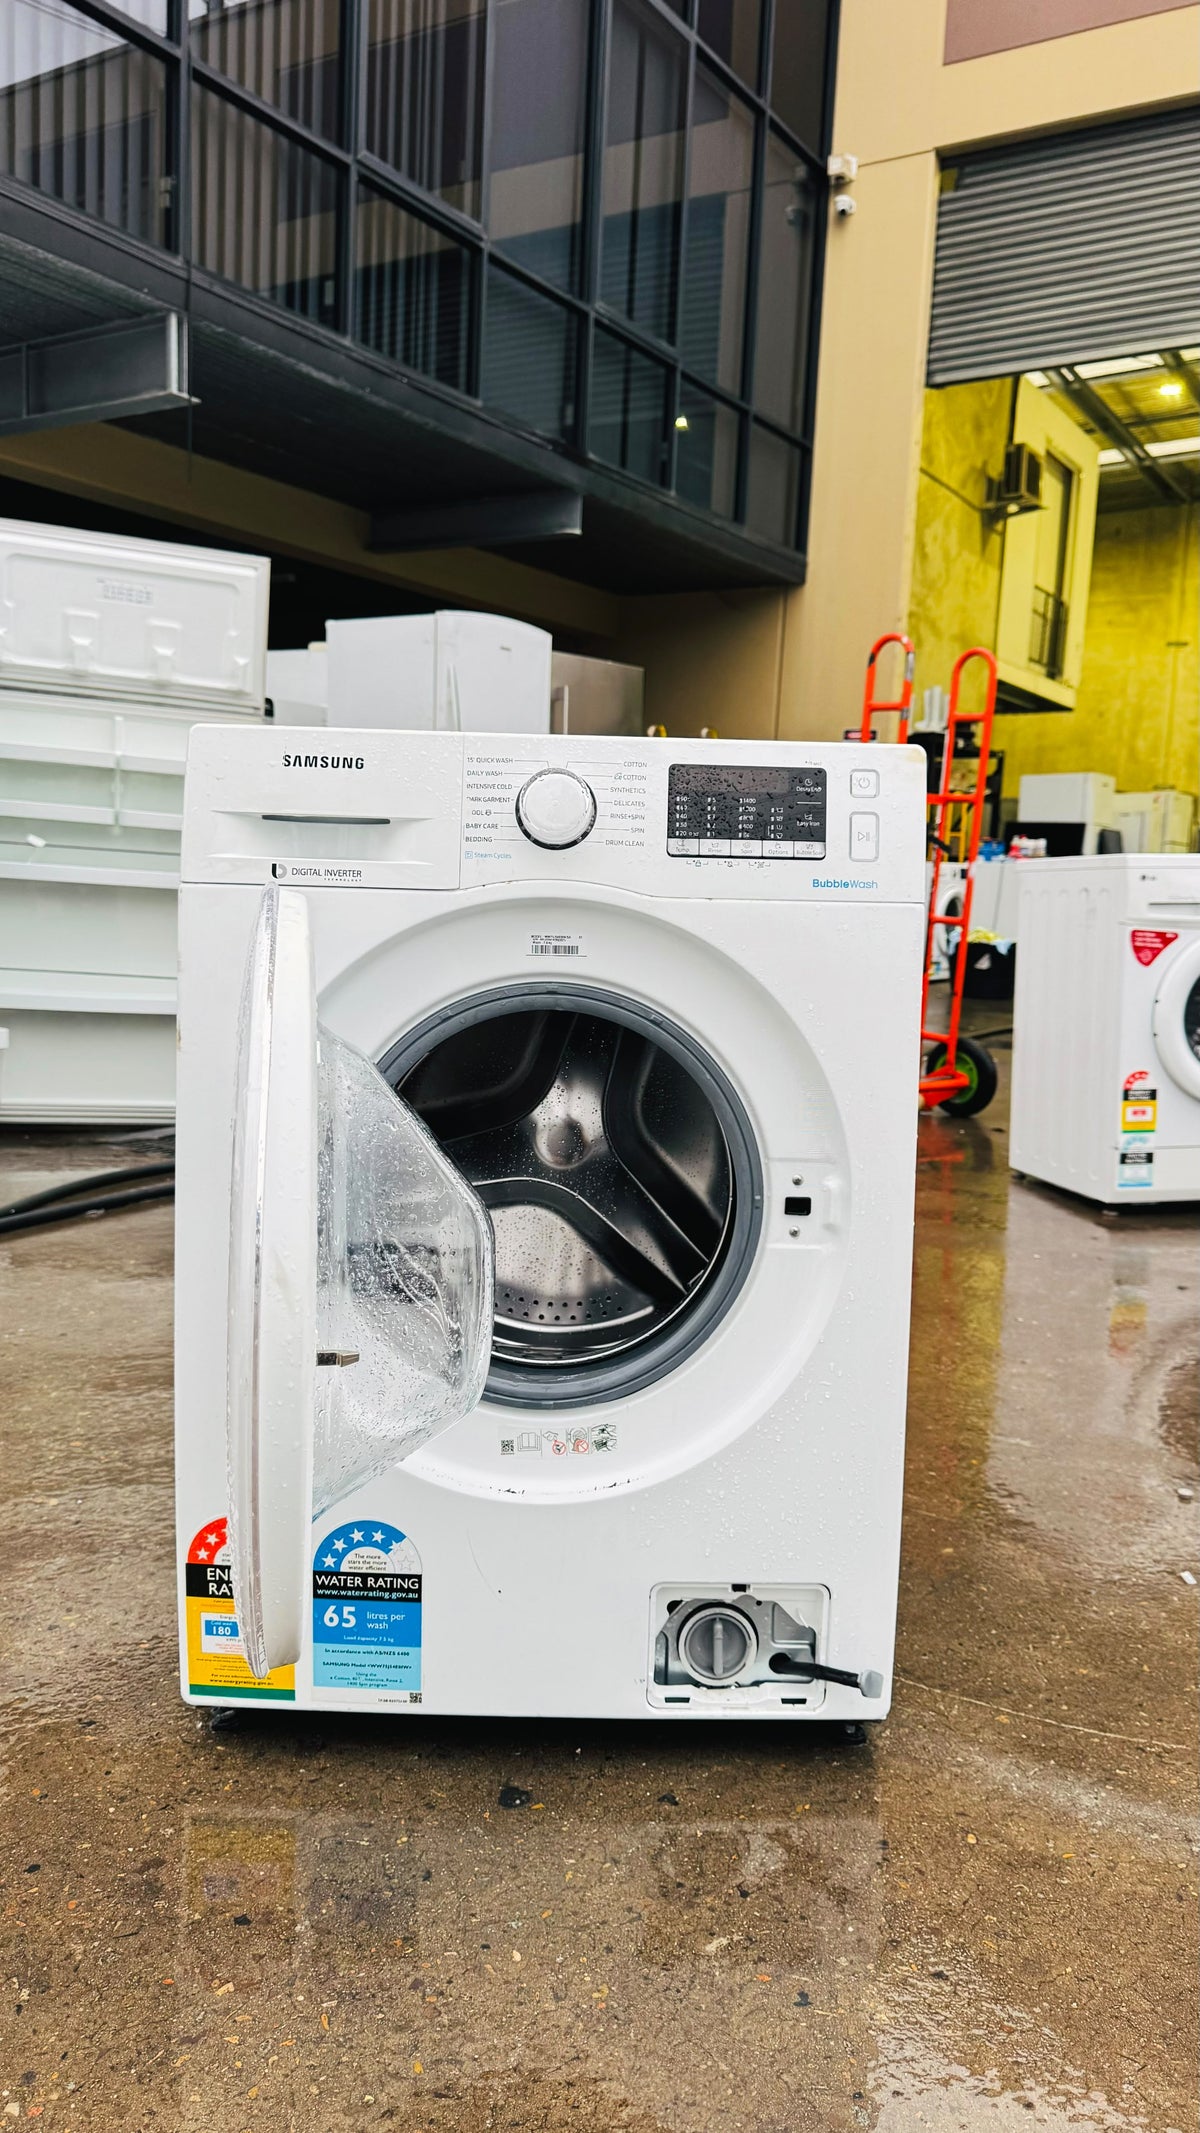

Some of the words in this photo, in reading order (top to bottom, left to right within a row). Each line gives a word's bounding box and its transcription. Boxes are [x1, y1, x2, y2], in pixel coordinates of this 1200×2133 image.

[284, 755, 365, 769] SAMSUNG
[610, 786, 646, 794] SYNTHETICS
[494, 852, 513, 860] Cycles
[292, 867, 322, 876] DIGITAL
[325, 868, 362, 878] INVERTER
[812, 879, 878, 889] BubbleWash
[315, 1574, 363, 1587] WATER
[367, 1577, 419, 1589] RATING
[316, 1588, 419, 1599] www.waterrating.gov.au
[323, 1605, 357, 1628] 65
[366, 1611, 388, 1620] litres
[390, 1613, 406, 1622] per
[212, 1625, 231, 1635] 180
[366, 1622, 388, 1630] wash
